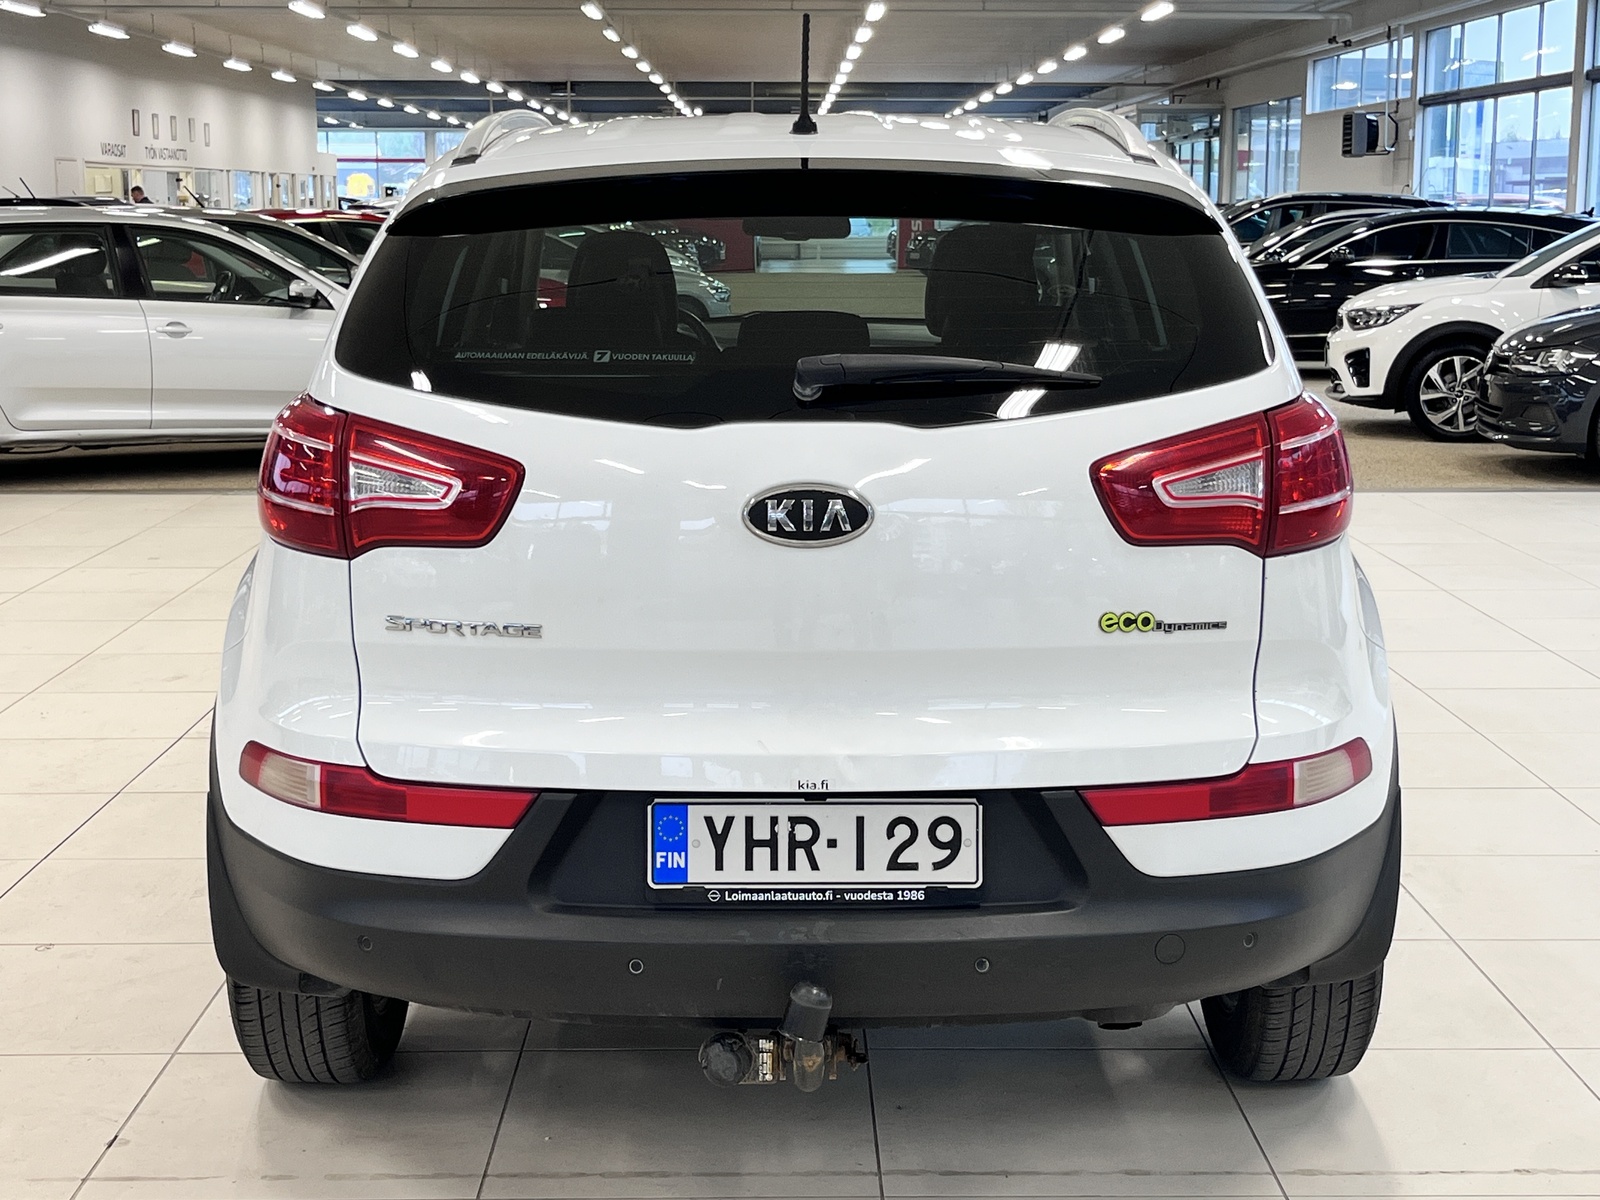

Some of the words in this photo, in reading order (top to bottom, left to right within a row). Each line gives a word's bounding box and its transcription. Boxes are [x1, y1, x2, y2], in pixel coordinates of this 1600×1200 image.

[100, 141, 127, 158] VARAOSAT
[144, 145, 158, 160] TYÖN
[454, 351, 525, 360] AUTOMAAILMAN
[612, 353, 650, 361] VUODEN
[764, 498, 853, 532] KIA
[385, 614, 543, 639] SPORTAGE
[797, 779, 830, 791] kia.fi
[703, 815, 963, 872] YHR-129
[655, 851, 686, 869] FIN
[724, 890, 834, 901] Loimaanlaatuauto.fi
[844, 890, 894, 901] vuodesta
[896, 890, 925, 901] 1986
